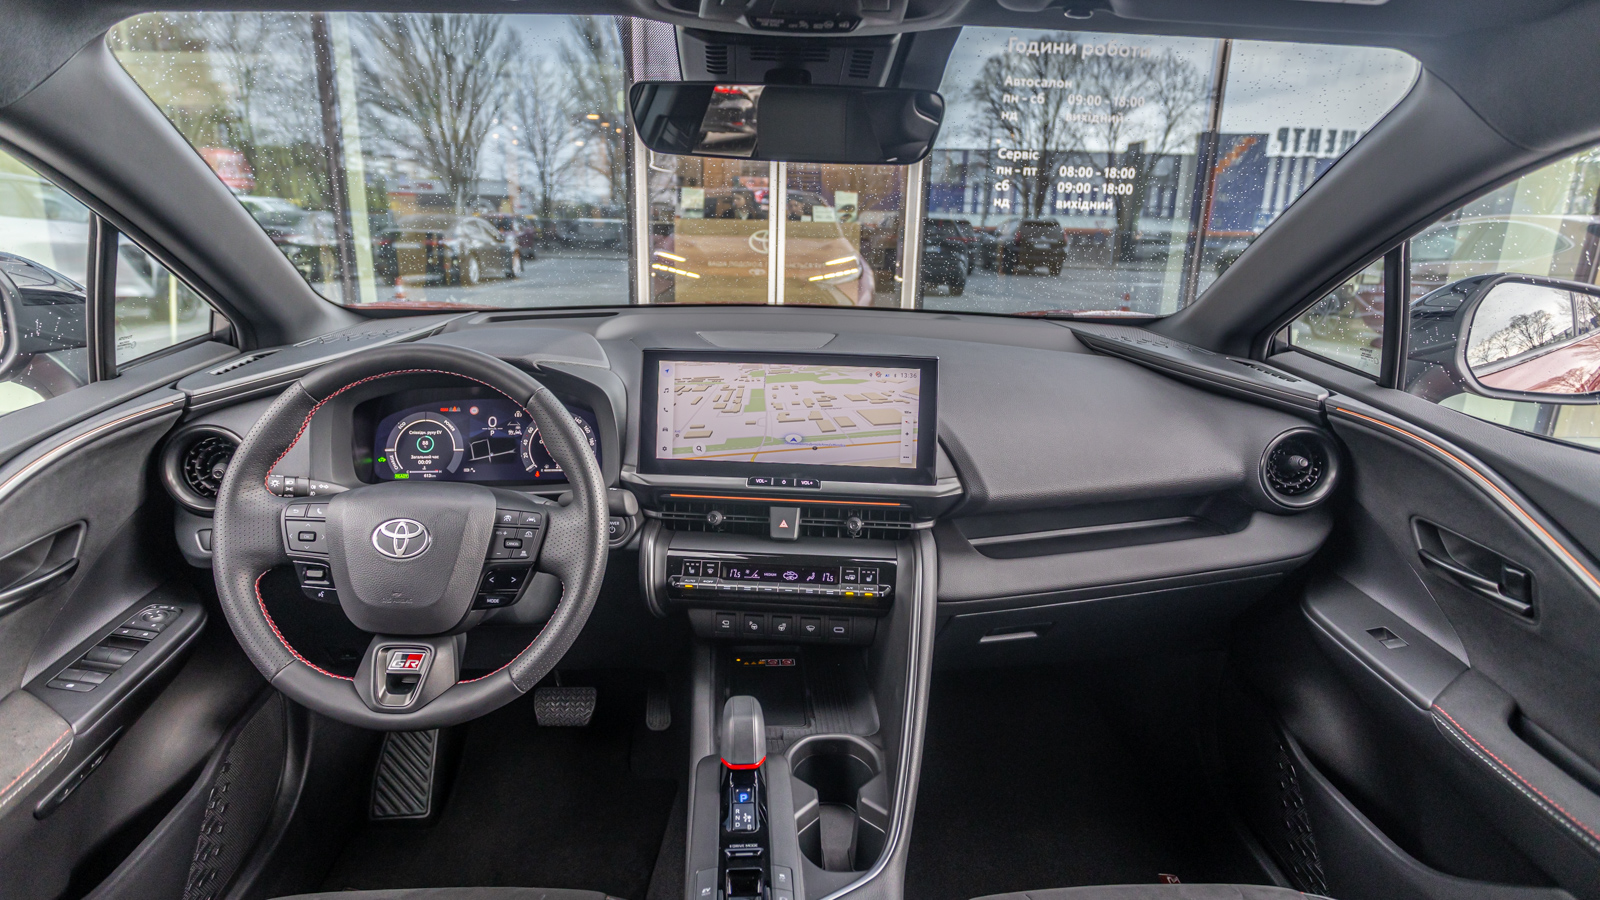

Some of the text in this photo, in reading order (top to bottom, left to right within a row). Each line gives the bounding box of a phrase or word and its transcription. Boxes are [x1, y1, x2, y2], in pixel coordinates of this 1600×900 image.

[1008, 36, 1150, 59] Години роботи
[1004, 76, 1072, 88] Автосалон
[1002, 94, 1019, 103] пн
[1030, 92, 1045, 104] сб
[1068, 94, 1102, 106] 09:00
[1113, 96, 1145, 108] 18:00
[1001, 111, 1124, 124] нд вихідний
[998, 148, 1039, 162] Сервіс
[996, 166, 1012, 176] пн
[1022, 167, 1038, 176] пт
[1059, 166, 1094, 178] 08:00
[1104, 168, 1136, 180] 18:00
[995, 180, 1010, 192] сб
[1057, 182, 1091, 194] 09:00
[1102, 184, 1133, 196] 18:00
[994, 197, 1113, 211] нд вихідний
[398, 422, 406, 430] ECO
[444, 420, 456, 431] POWER
[488, 416, 497, 427] 0
[740, 794, 748, 802] P
